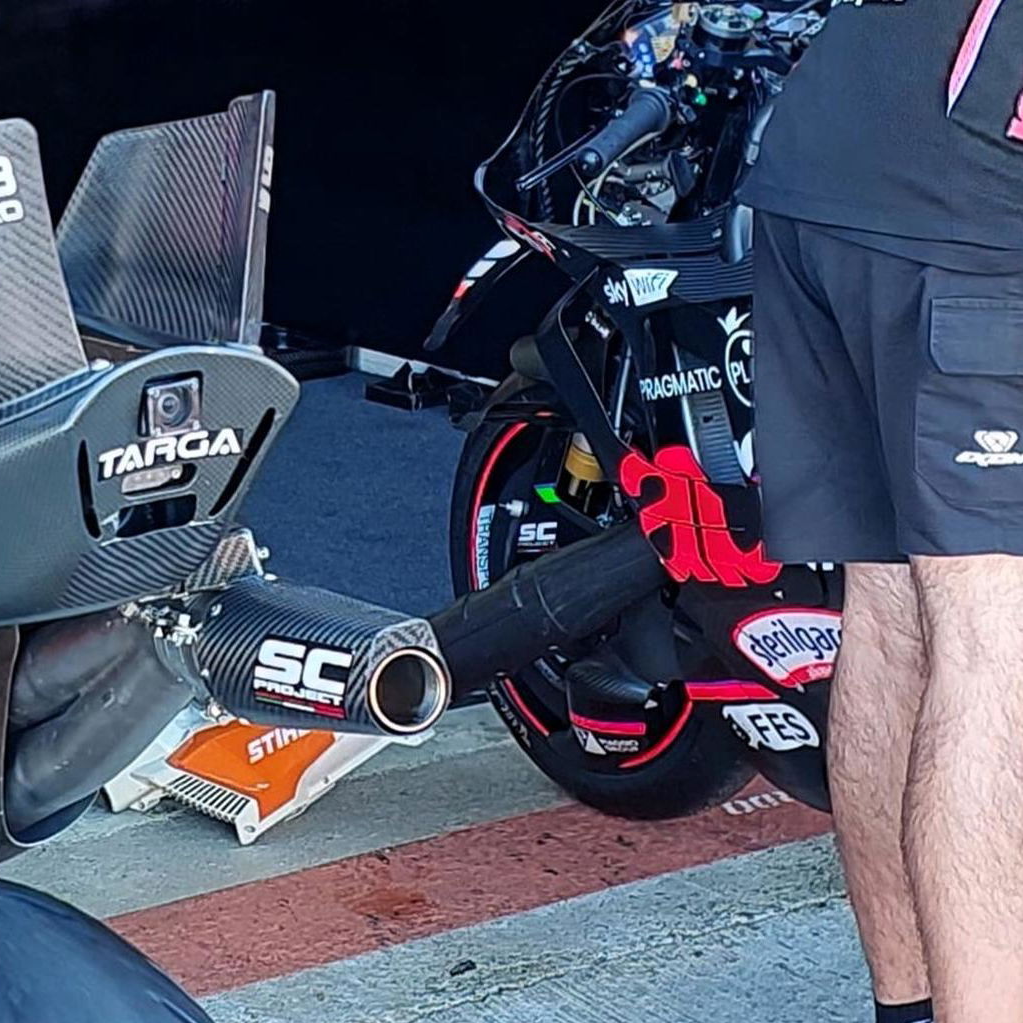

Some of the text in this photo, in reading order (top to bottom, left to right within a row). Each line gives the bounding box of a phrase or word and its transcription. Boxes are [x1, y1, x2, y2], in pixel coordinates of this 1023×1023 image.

[603, 277, 629, 307] sky
[639, 366, 723, 401] PRAGMATIC
[98, 428, 242, 479] TARGA
[518, 522, 557, 541] SC
[254, 639, 353, 696] SC
[253, 677, 344, 706] PROJECT
[748, 712, 811, 743] FES
